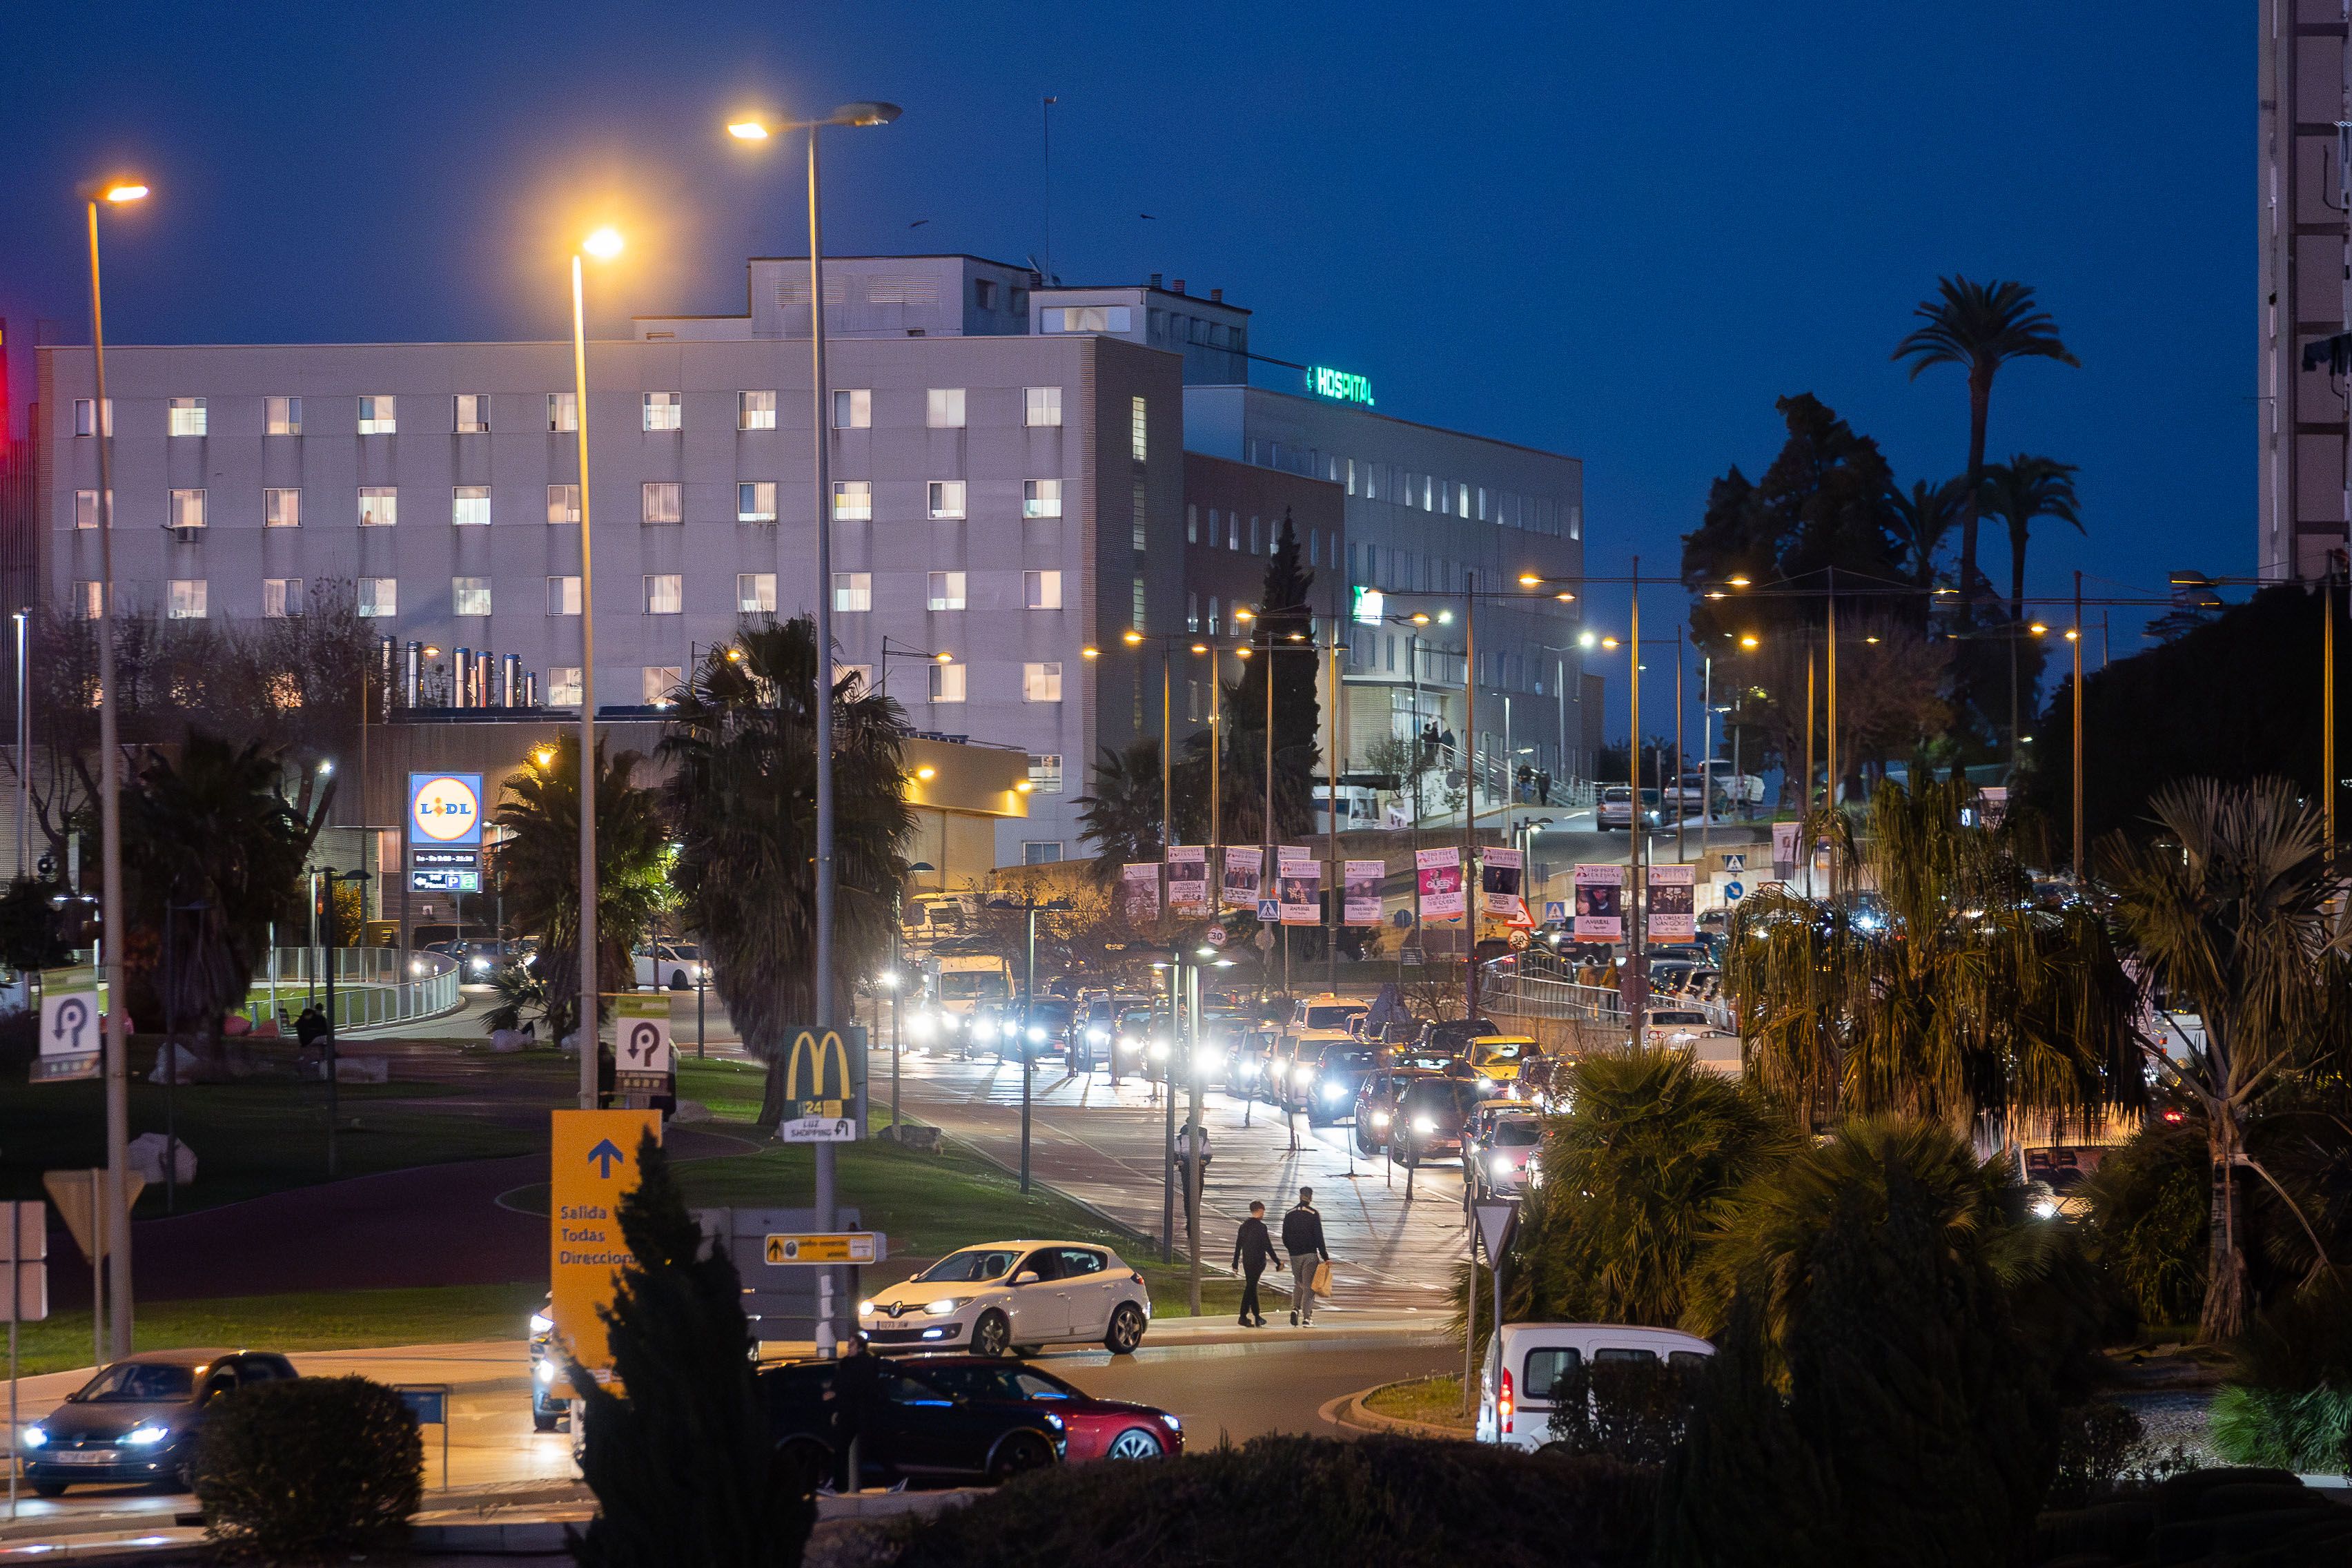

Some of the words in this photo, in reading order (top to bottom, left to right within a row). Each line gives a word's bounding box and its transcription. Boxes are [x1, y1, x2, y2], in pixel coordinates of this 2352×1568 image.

[1317, 366, 1375, 406] HOSPITAL
[448, 876, 459, 888] P
[1211, 932, 1222, 940] 30
[805, 1101, 823, 1114] 24
[791, 1128, 832, 1137] SHOPPING
[560, 1206, 608, 1220] Salida
[560, 1228, 606, 1242] Todas
[559, 1249, 634, 1265] Direccion
